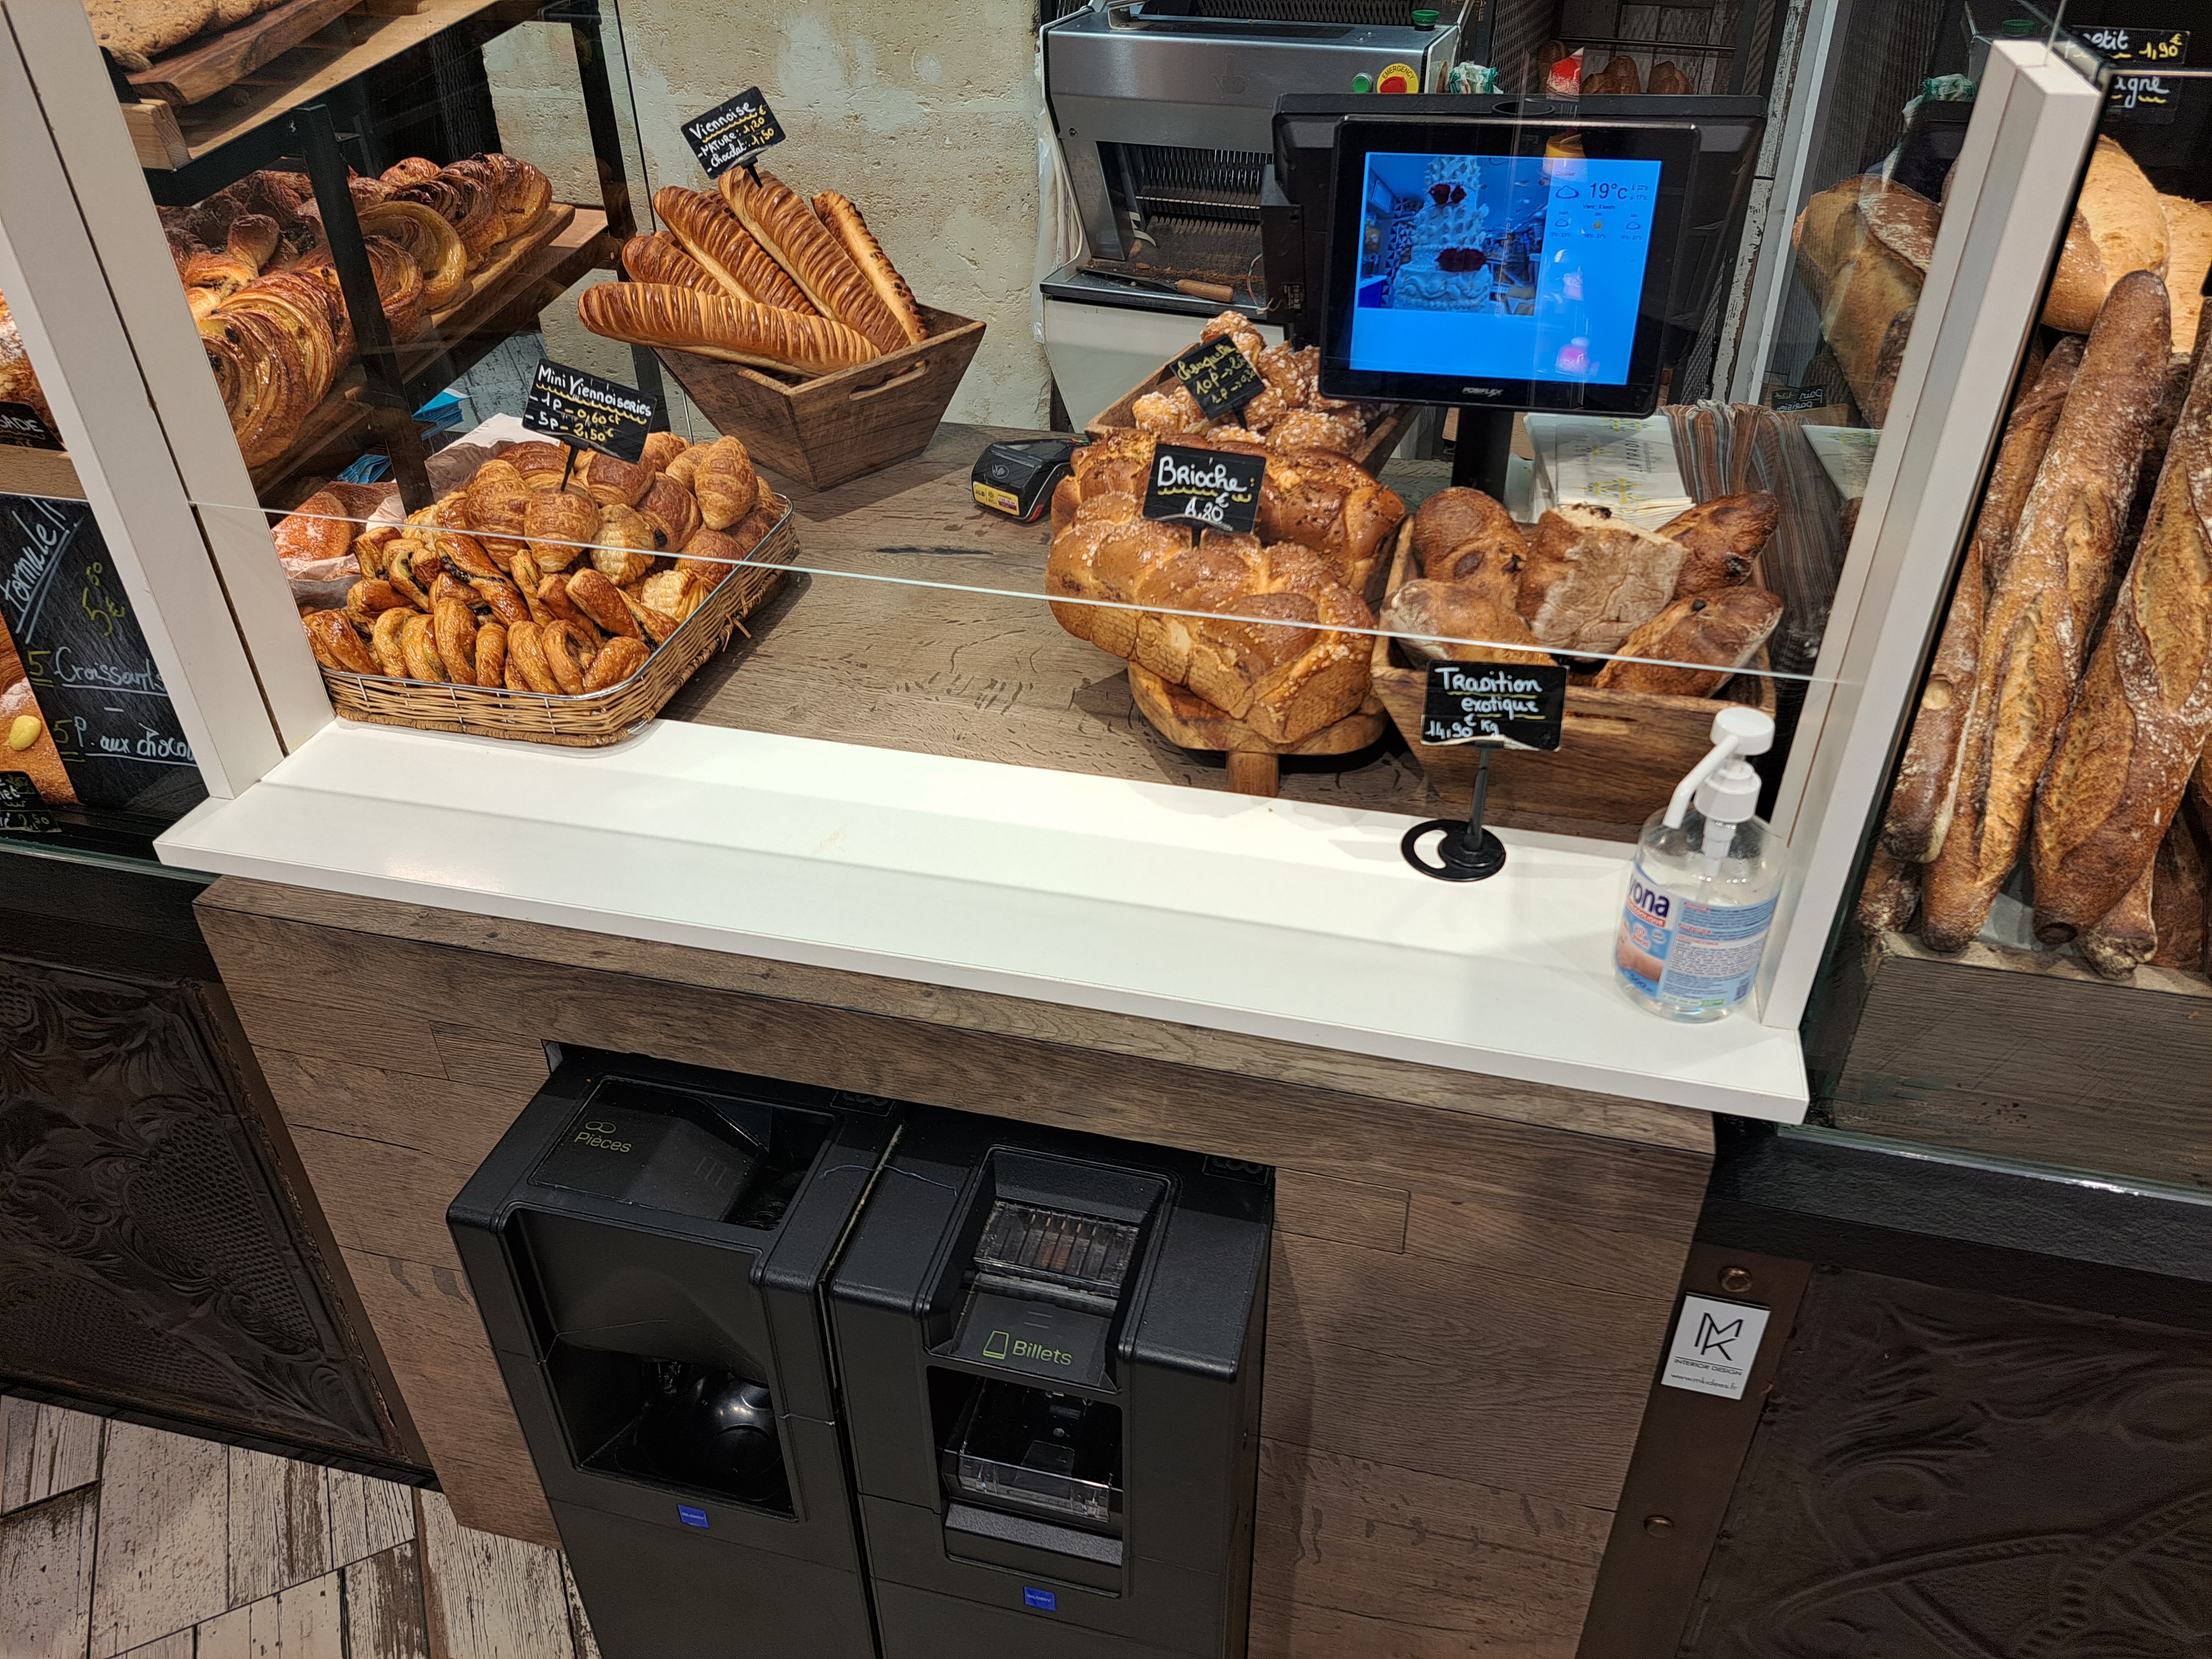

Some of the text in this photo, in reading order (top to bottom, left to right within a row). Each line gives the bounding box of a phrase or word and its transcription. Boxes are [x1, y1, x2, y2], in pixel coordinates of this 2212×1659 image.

[1382, 65, 1416, 79] EMERGENCY
[689, 102, 756, 139] Viennoise
[752, 127, 774, 145] 1,50
[538, 365, 565, 388] Mini
[1462, 387, 1504, 398] POSIFLEX
[577, 409, 607, 425] 0,60
[574, 423, 608, 442] 2,50
[1461, 695, 1539, 720] exotique
[100, 735, 131, 753] aux
[574, 1131, 631, 1152] Pièces
[1012, 1340, 1073, 1365] Billets
[1674, 1359, 1742, 1376] INTERIOR DESIGN
